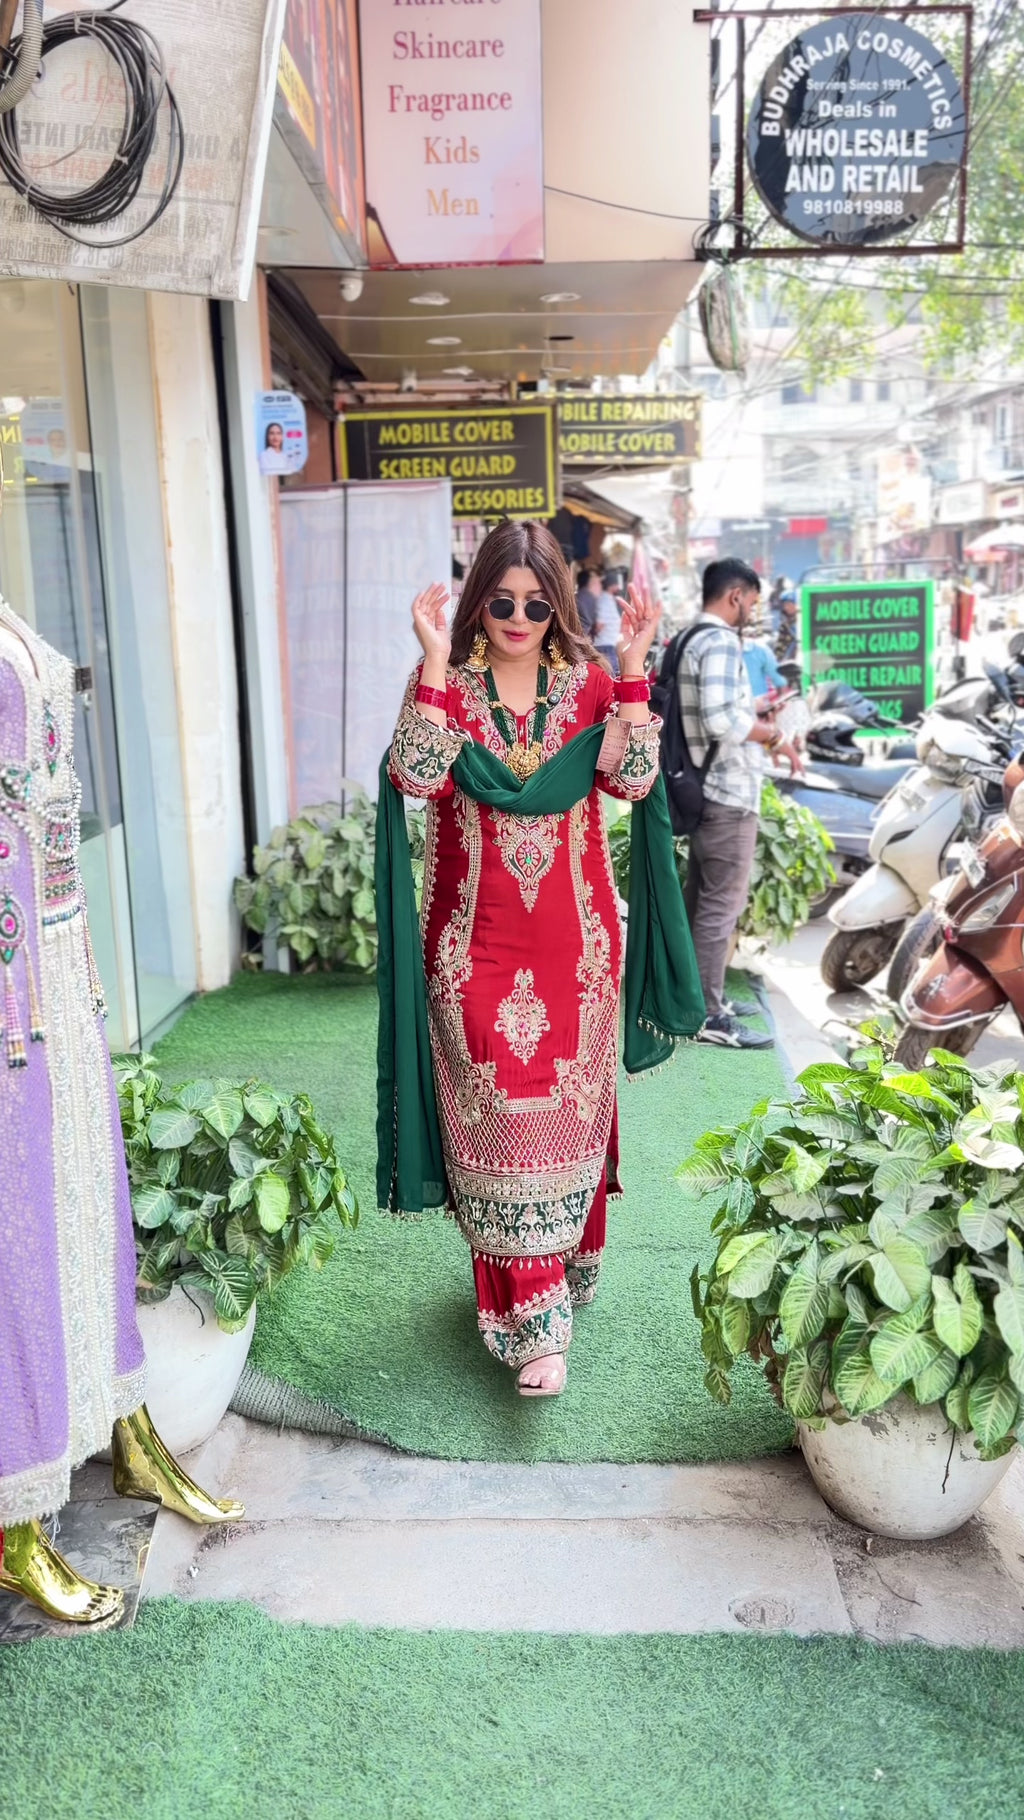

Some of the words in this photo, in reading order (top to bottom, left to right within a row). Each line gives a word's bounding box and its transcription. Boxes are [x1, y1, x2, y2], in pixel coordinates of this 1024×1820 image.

[393, 31, 504, 60] Skincare
[761, 32, 849, 136] BUDHRAJA
[856, 30, 951, 129] COSMETICS
[806, 79, 847, 93] Serving
[849, 79, 879, 91] Since
[388, 85, 512, 121] Fragrance
[819, 101, 872, 118] Deals
[878, 101, 897, 118] in
[423, 136, 480, 165] Kids
[784, 128, 928, 157] WHOLESALE
[784, 164, 834, 193] AND
[842, 164, 924, 193] RETAIL
[427, 188, 479, 216] Men
[803, 199, 904, 215] 9810819988
[559, 402, 598, 420] BILE
[601, 401, 695, 420] REPAIRING
[379, 422, 450, 445] MOBILE
[453, 420, 515, 442] COVER
[618, 432, 675, 452] COVER
[379, 457, 447, 479] SCREEN
[450, 454, 517, 477] GUARD
[453, 487, 545, 511] CESSORIES
[816, 598, 871, 622] MOBILE
[872, 596, 919, 619] COVER
[815, 633, 866, 655] SCREEN
[868, 631, 920, 653] GUARD
[869, 665, 922, 687] REPAIR
